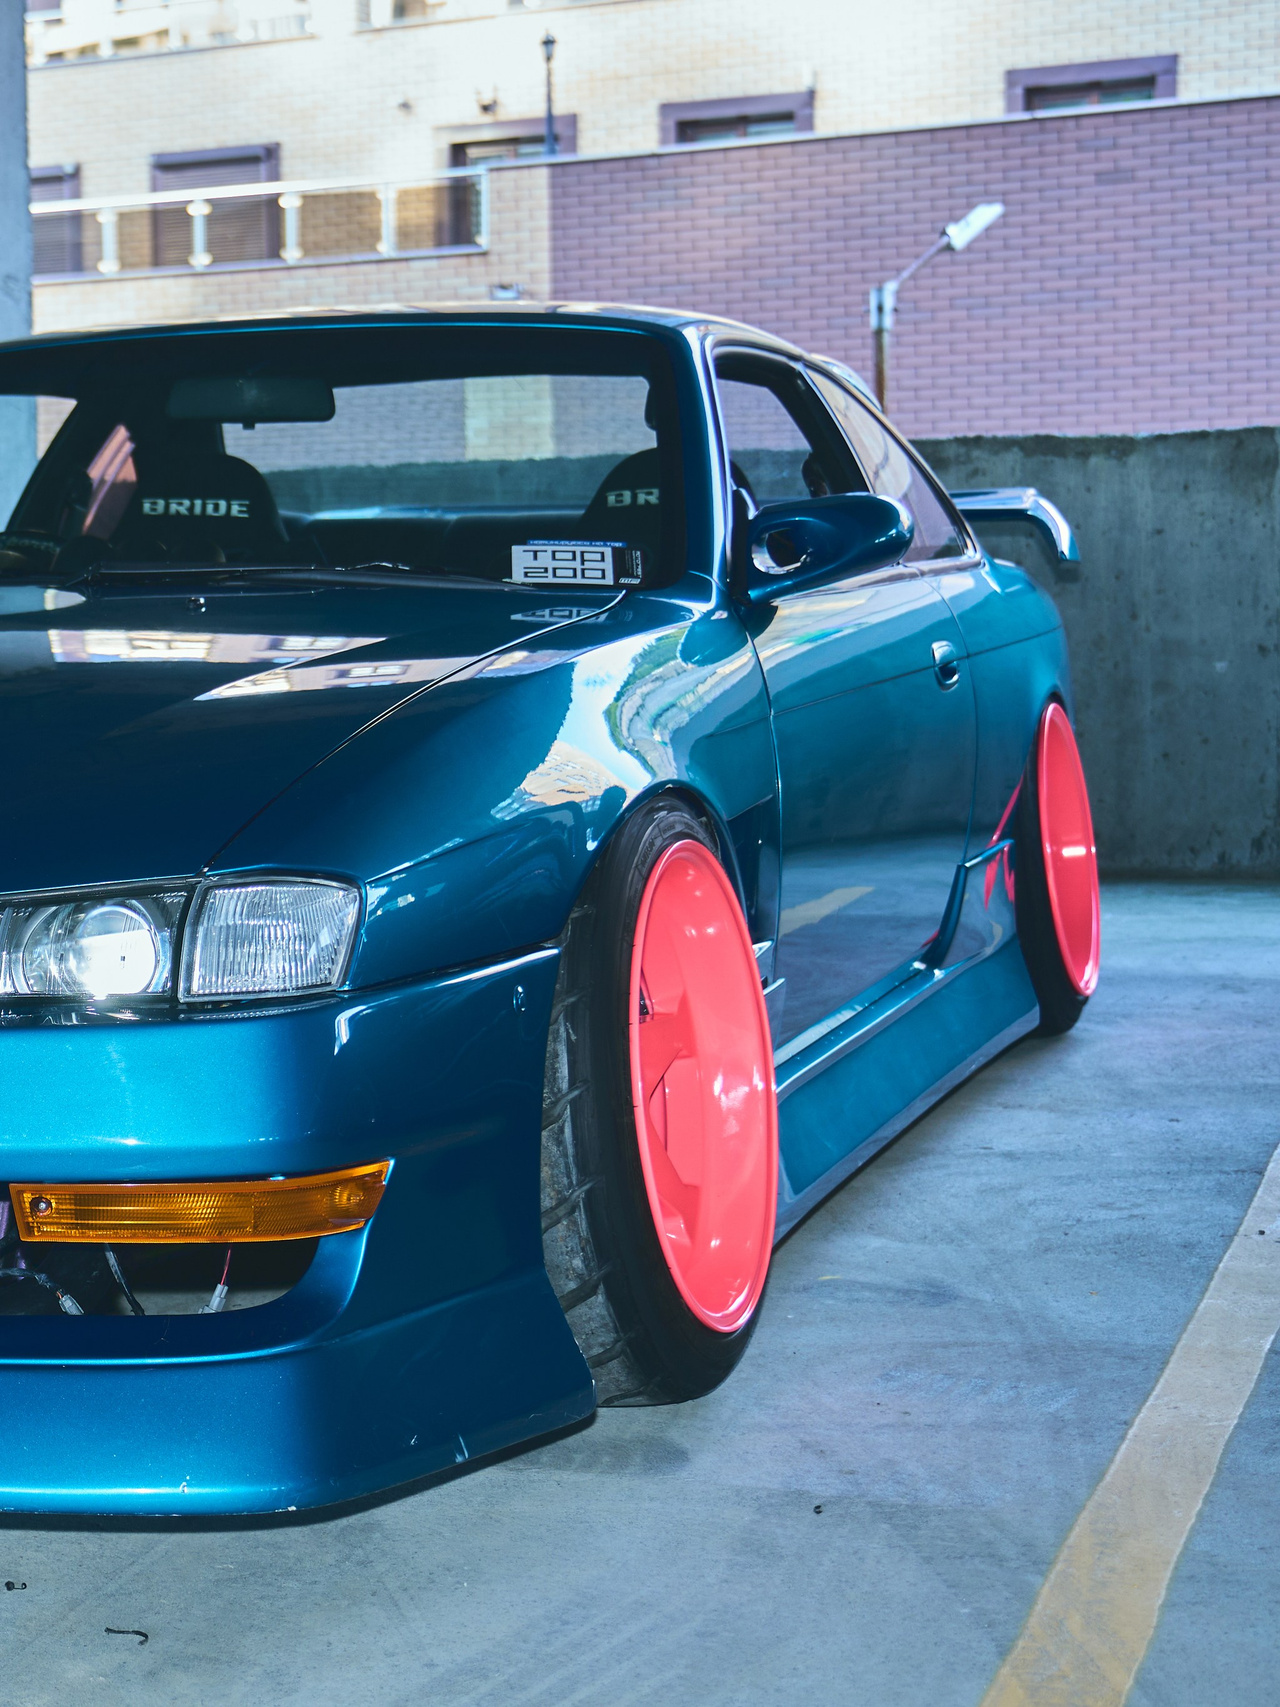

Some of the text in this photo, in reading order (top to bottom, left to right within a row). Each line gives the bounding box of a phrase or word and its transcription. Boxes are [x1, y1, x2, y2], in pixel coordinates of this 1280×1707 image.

[606, 488, 660, 507] BR
[142, 499, 250, 518] BRIDE
[522, 549, 606, 567] TOP
[523, 566, 606, 580] 200
